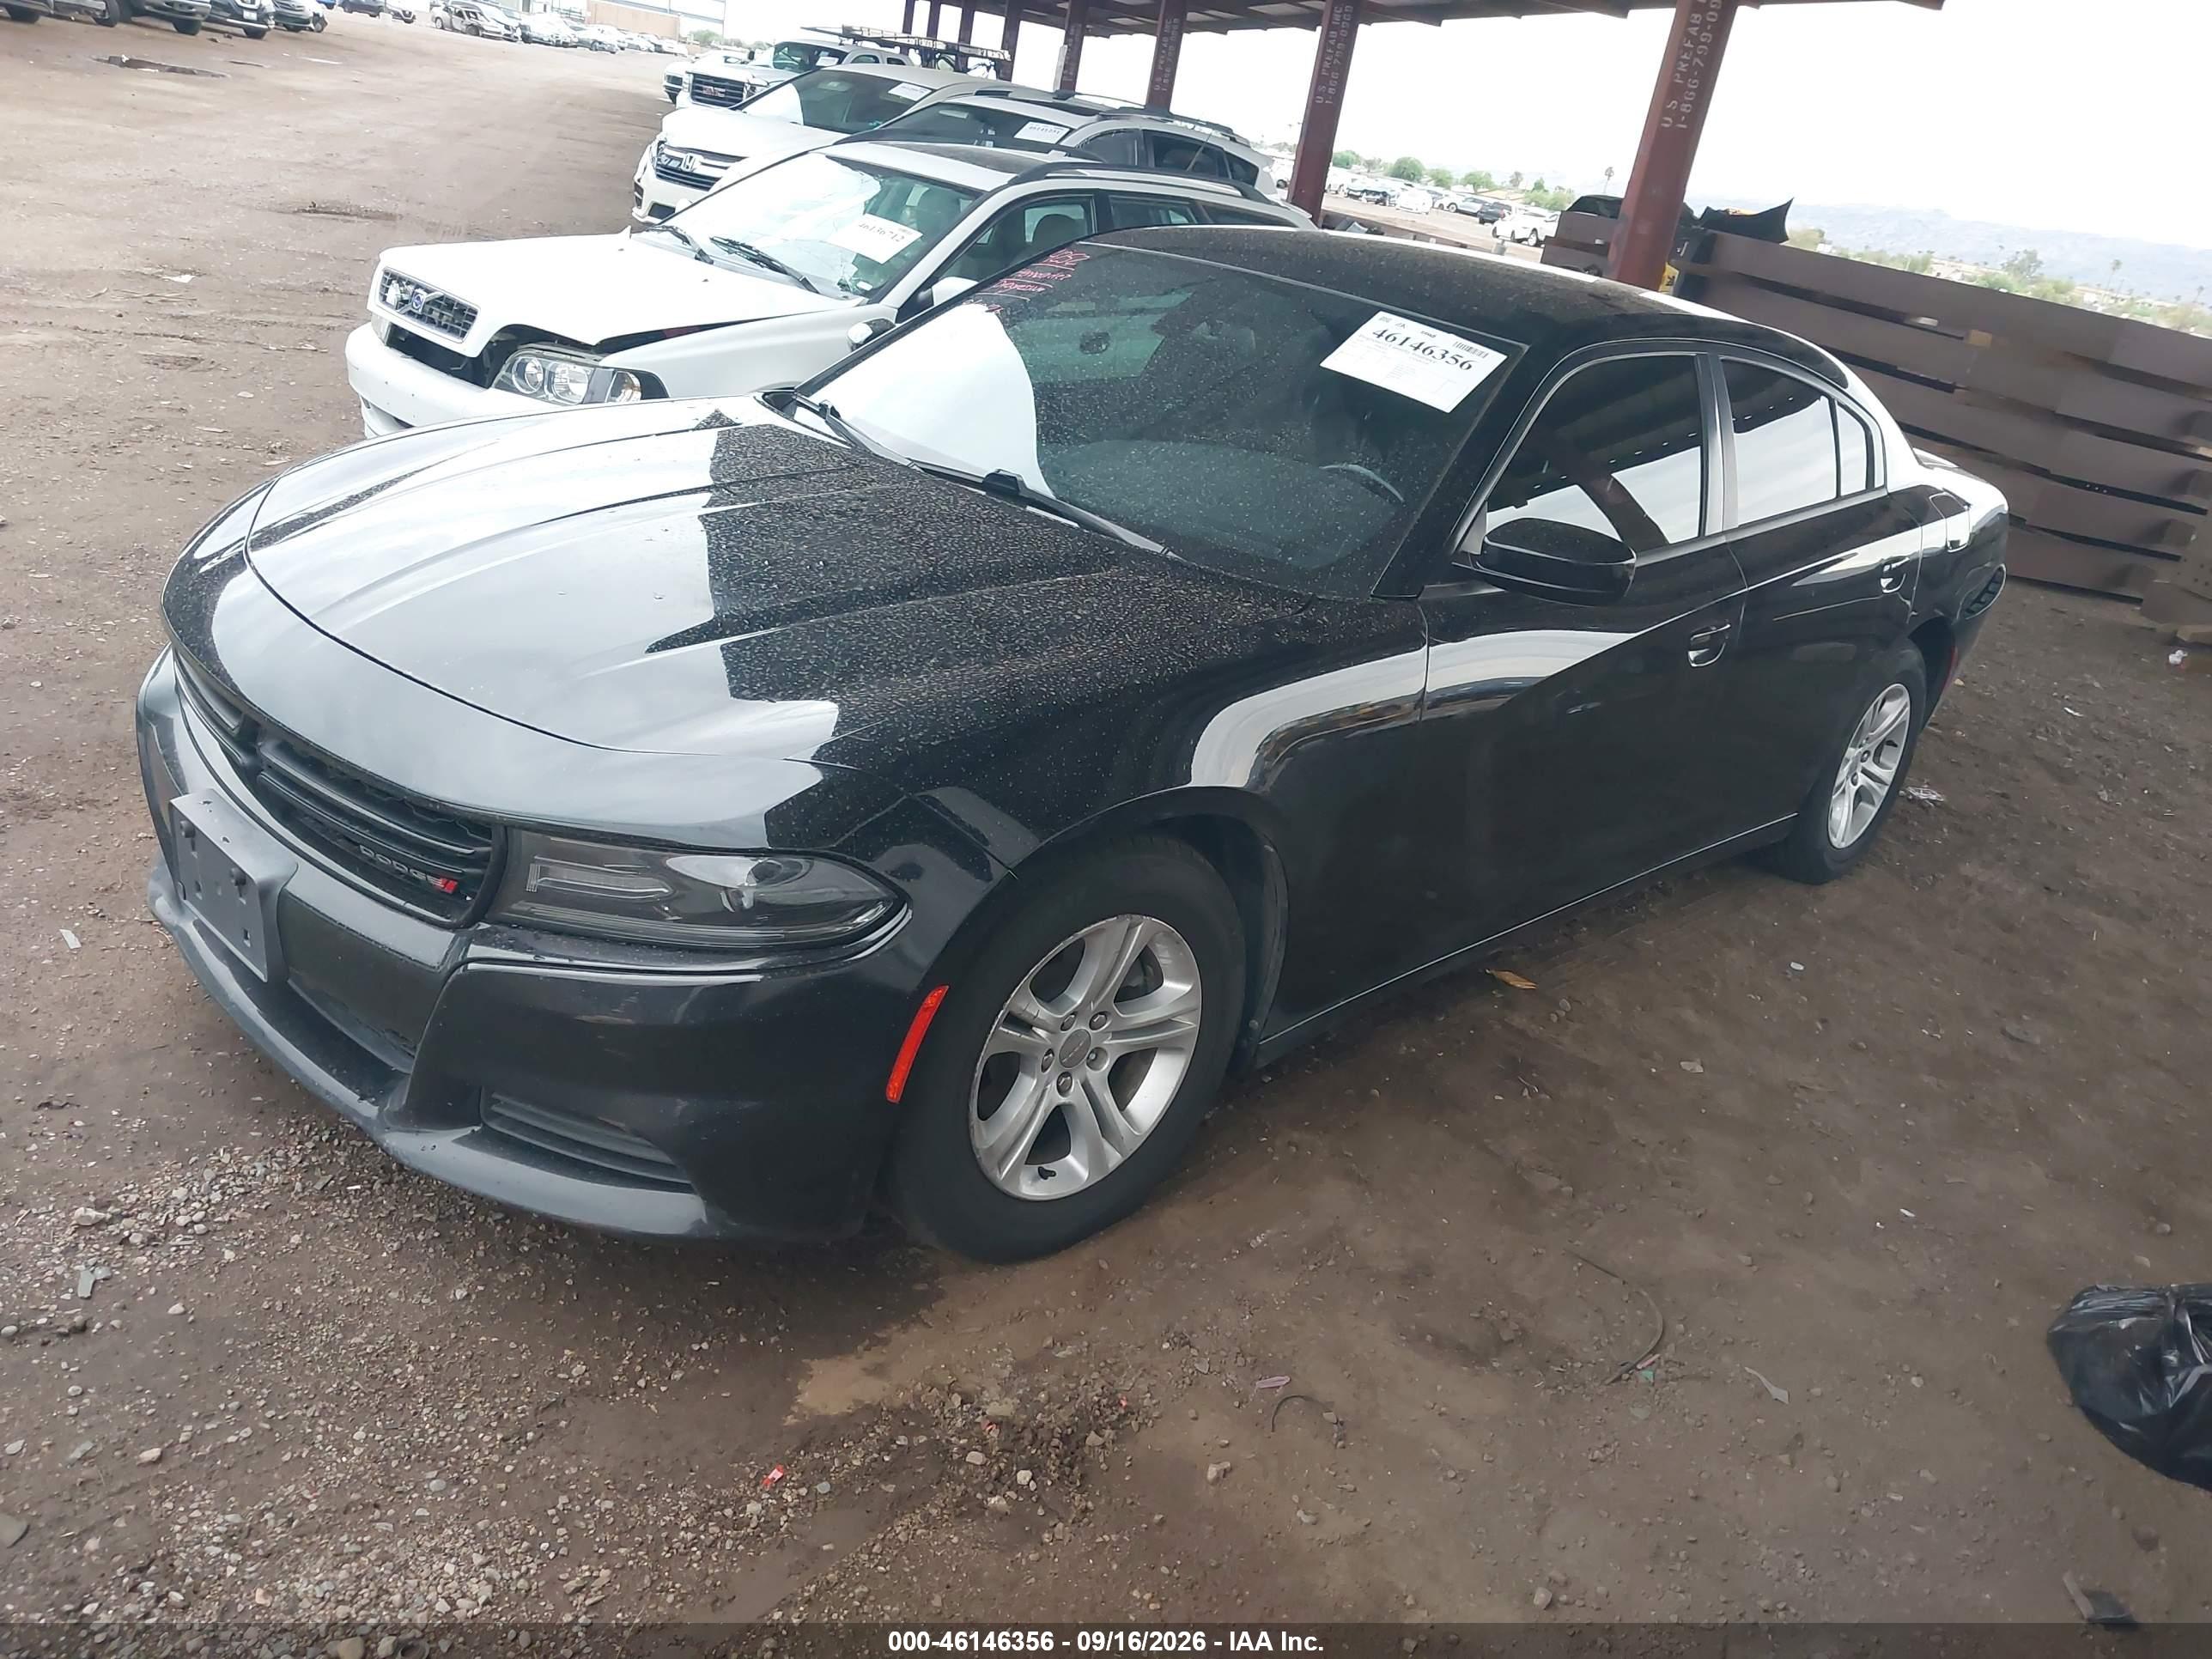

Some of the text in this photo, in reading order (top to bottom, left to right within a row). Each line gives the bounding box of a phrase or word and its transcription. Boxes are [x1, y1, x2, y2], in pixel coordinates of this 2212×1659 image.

[1661, 117, 1673, 128] U
[1667, 100, 1678, 110] S
[1674, 13, 1703, 83] PREFAB
[1372, 329, 1476, 370] 46146356
[359, 844, 445, 888] DODGE
